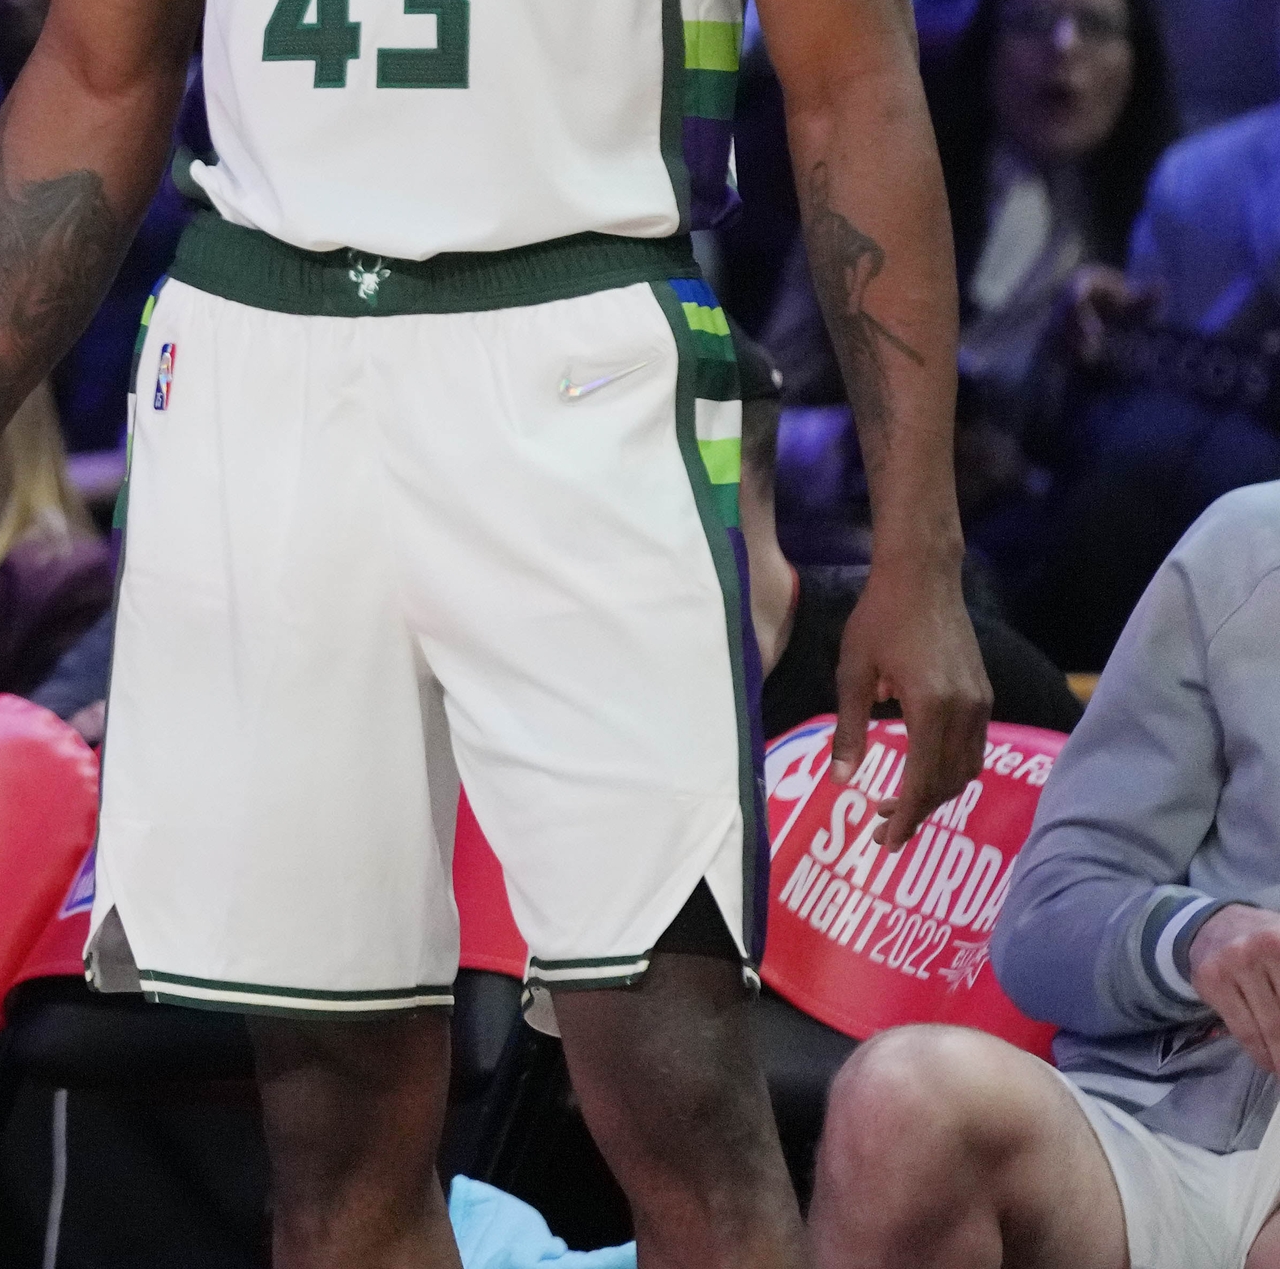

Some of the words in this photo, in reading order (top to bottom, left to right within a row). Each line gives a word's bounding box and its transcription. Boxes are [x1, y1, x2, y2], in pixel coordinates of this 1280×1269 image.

[779, 854, 892, 955] NIGHT
[869, 906, 952, 980] 2022
[810, 789, 1018, 933] SATURDA
